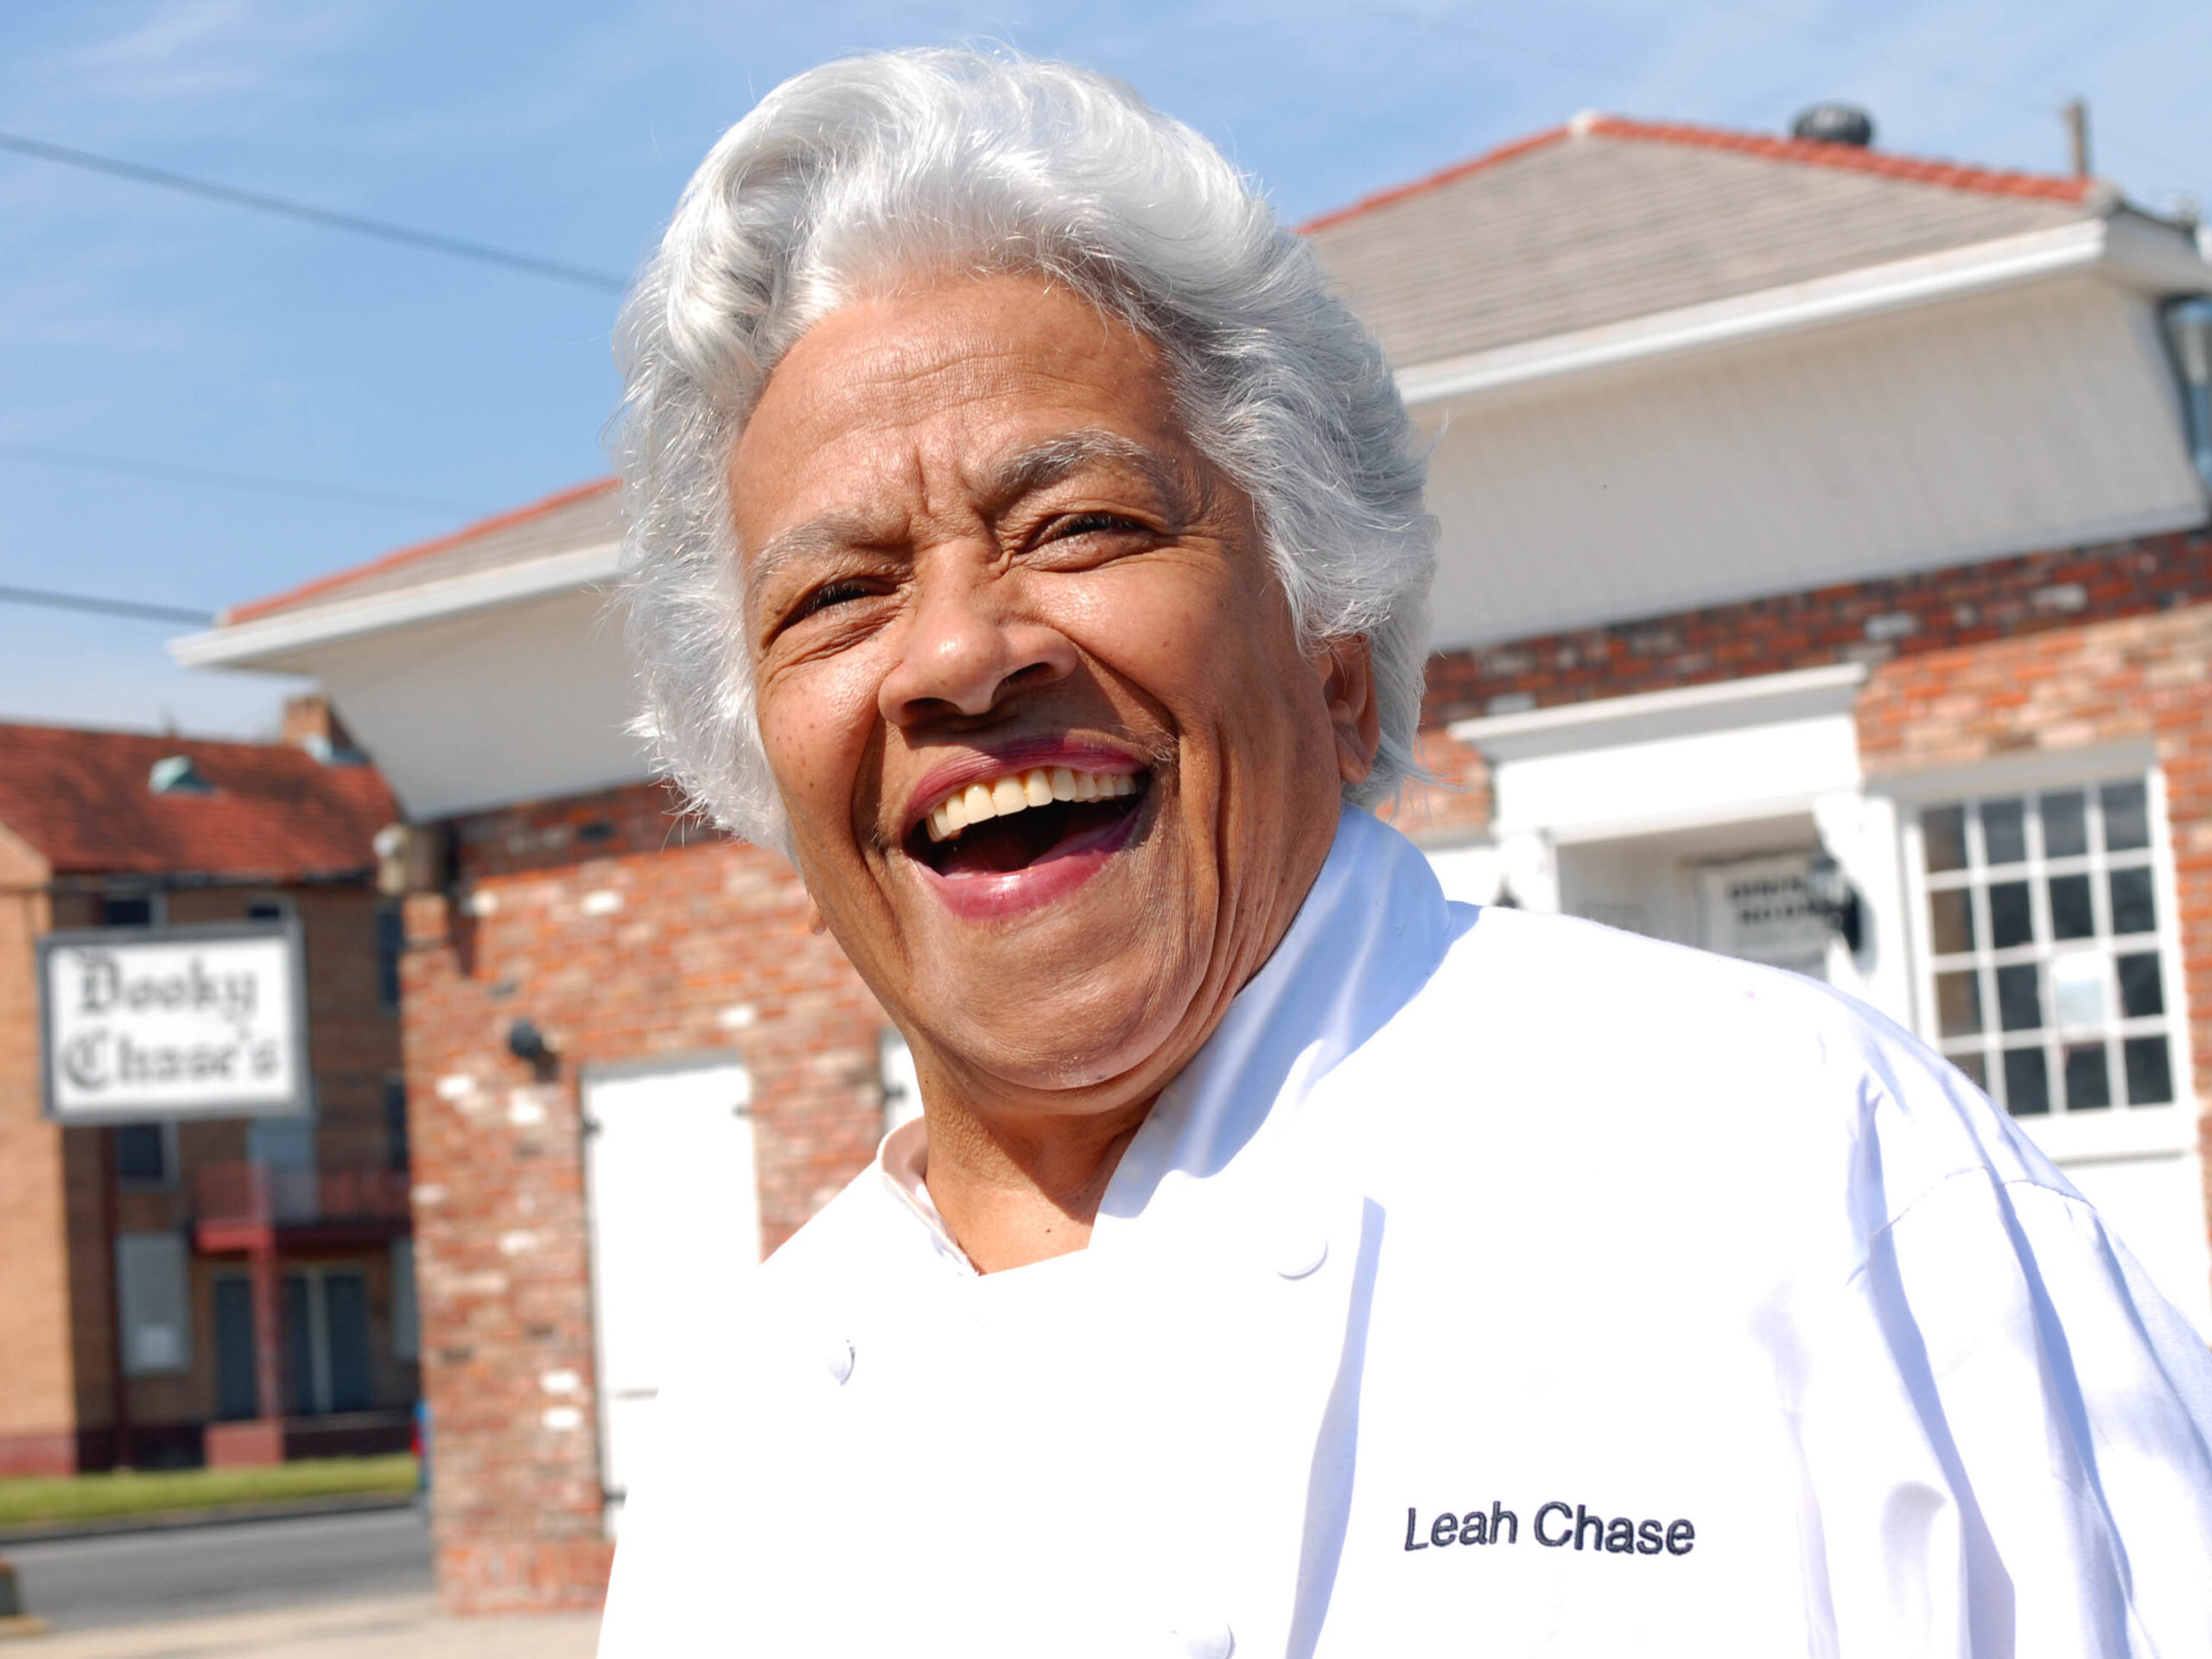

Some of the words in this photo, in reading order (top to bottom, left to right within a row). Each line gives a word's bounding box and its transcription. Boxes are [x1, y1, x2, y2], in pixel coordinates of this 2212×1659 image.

[74, 946, 257, 1023] Dooky
[63, 1027, 280, 1092] Chase's
[1404, 1500, 1518, 1551] Leah
[1533, 1501, 1695, 1555] Chase
